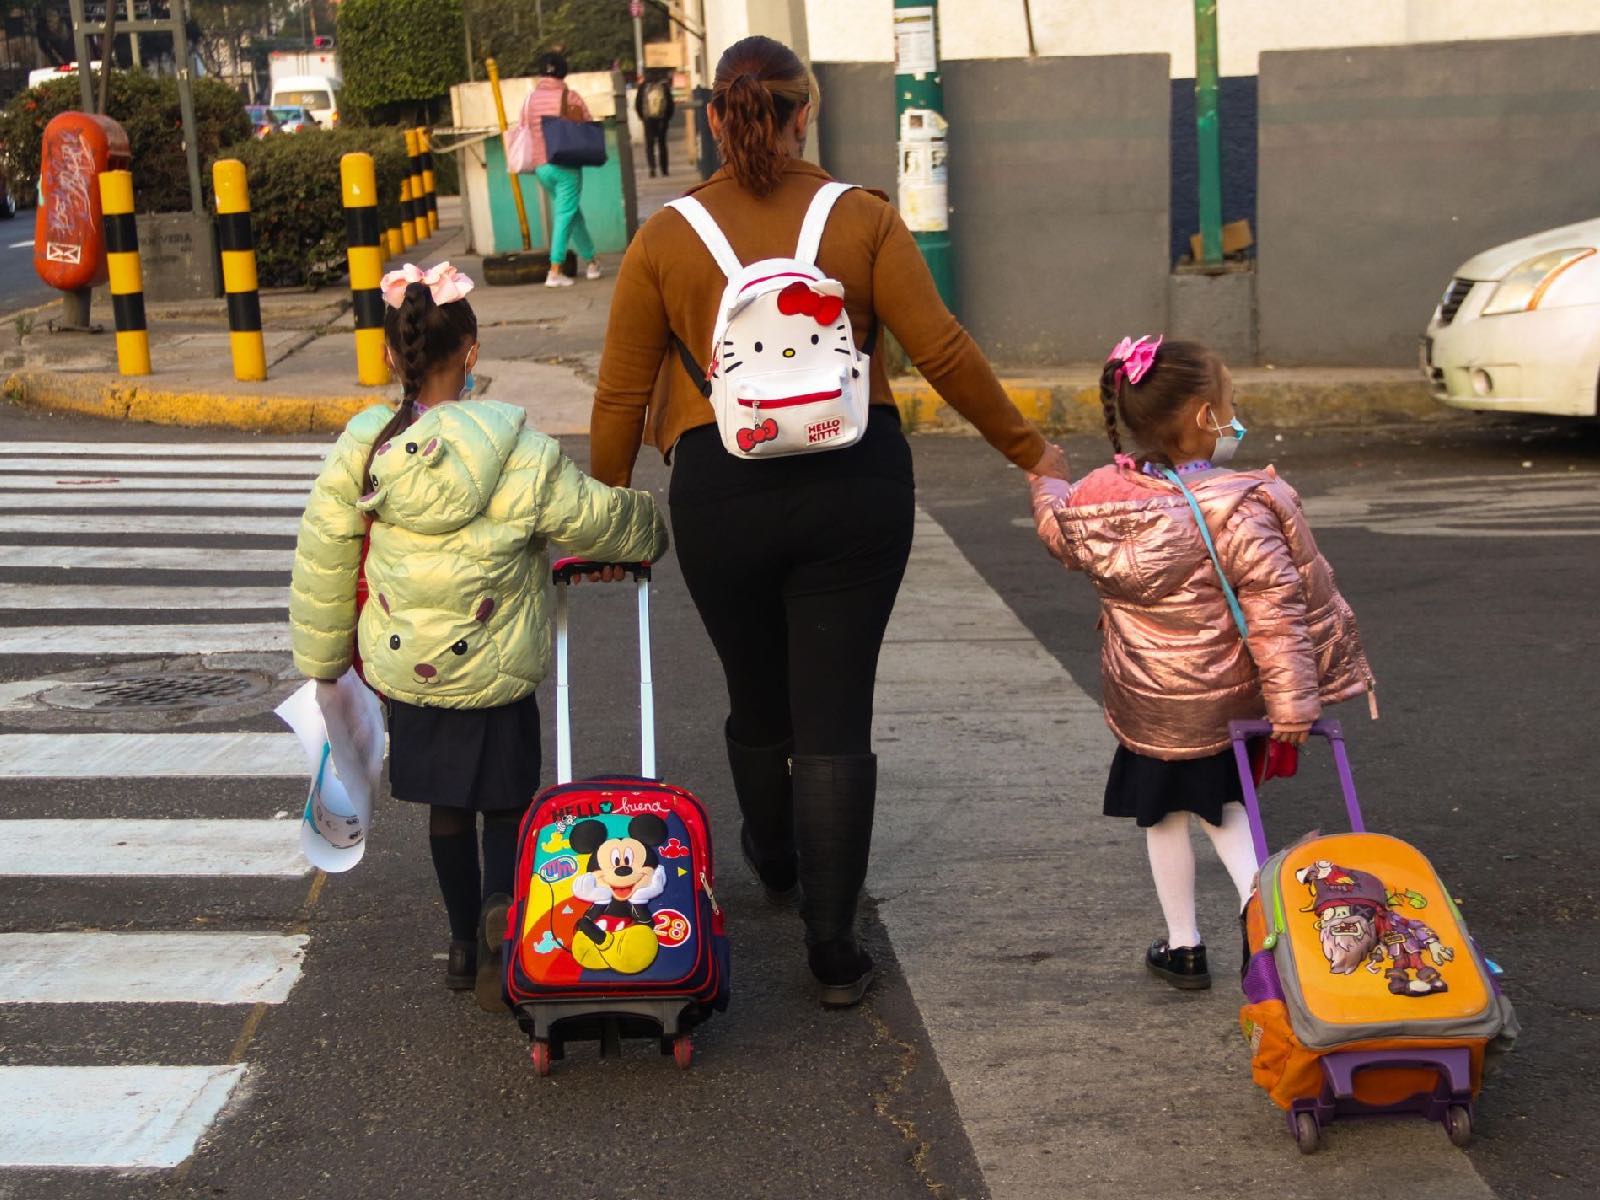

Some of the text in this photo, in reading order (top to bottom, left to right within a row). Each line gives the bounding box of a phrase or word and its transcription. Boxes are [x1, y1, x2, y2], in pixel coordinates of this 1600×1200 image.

[808, 419, 840, 434] HELLO
[808, 427, 840, 443] KITTY
[654, 914, 686, 941] 28
